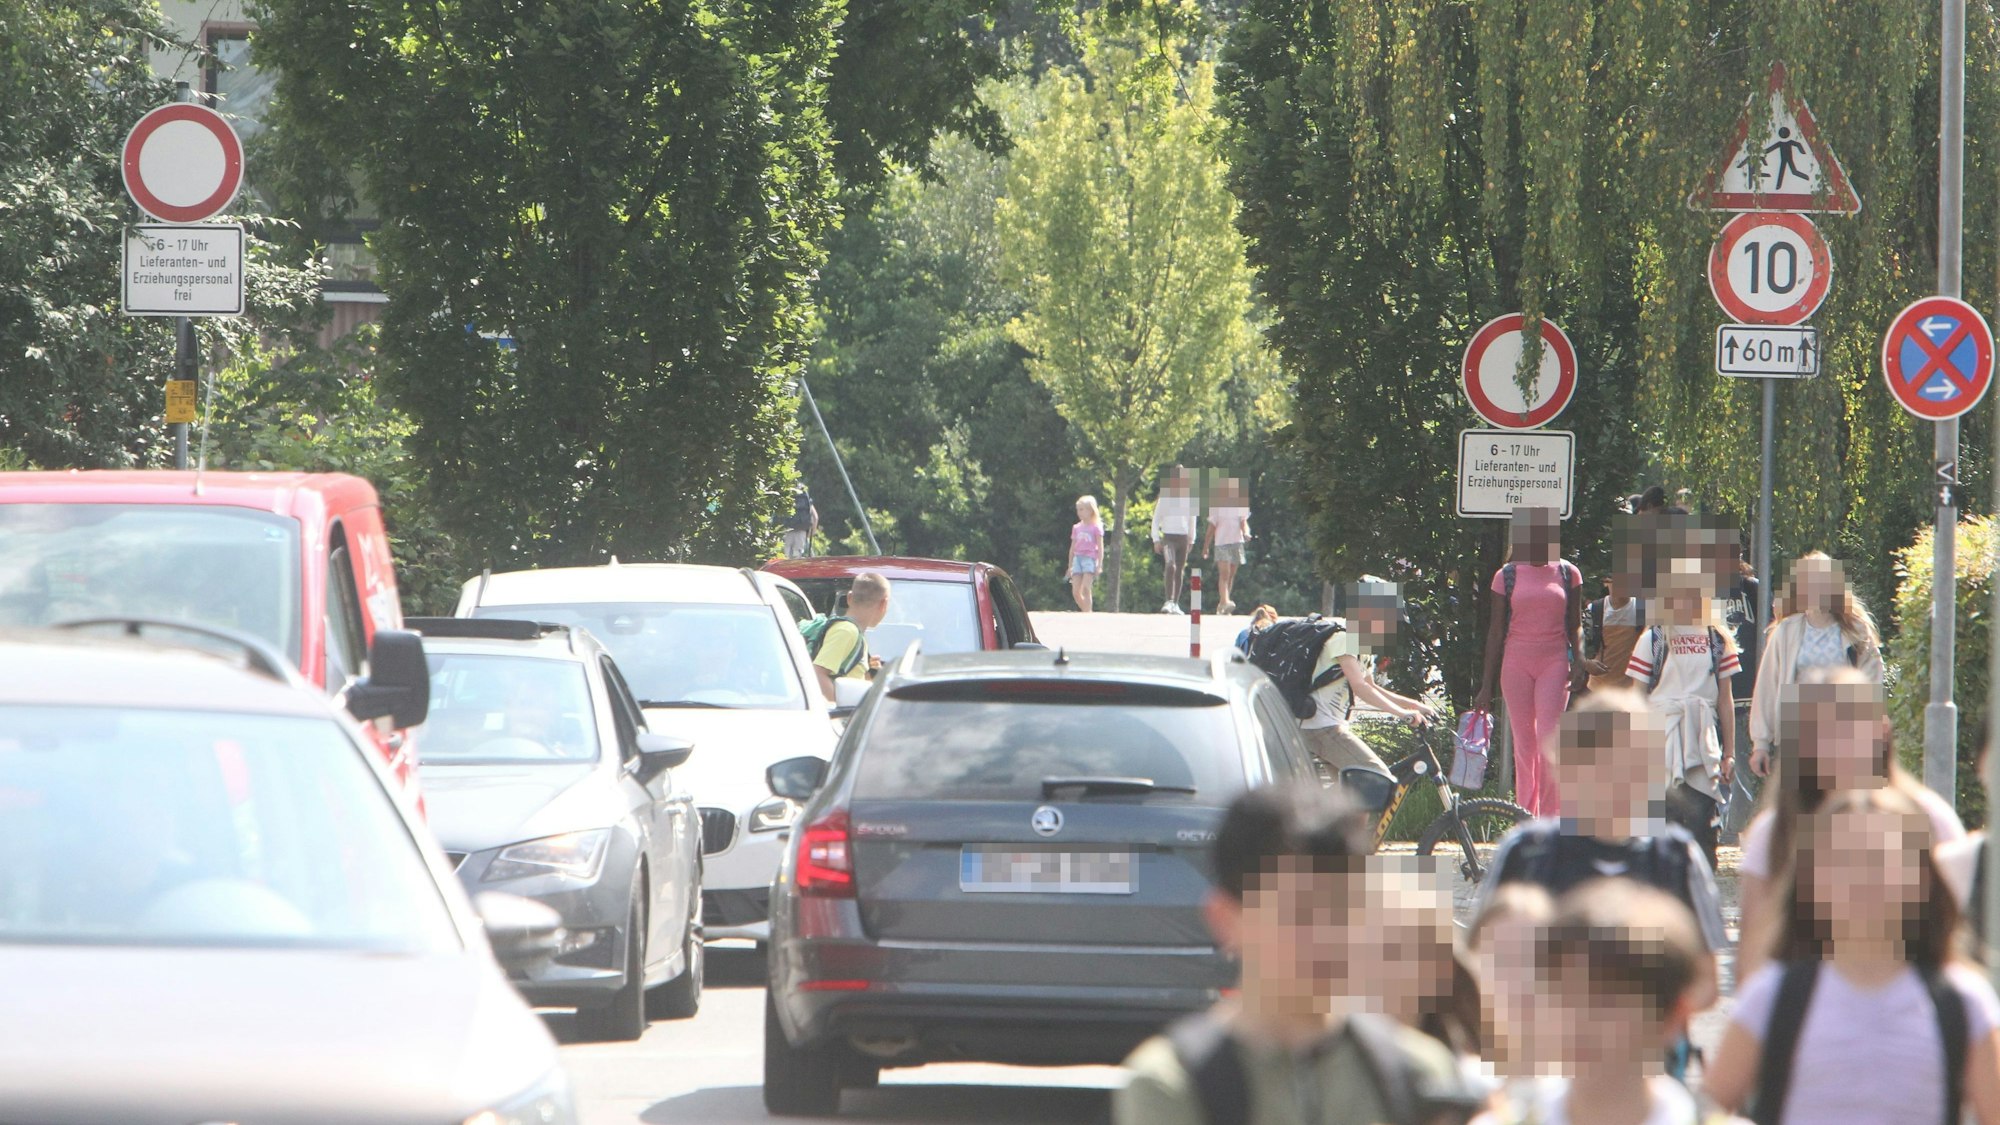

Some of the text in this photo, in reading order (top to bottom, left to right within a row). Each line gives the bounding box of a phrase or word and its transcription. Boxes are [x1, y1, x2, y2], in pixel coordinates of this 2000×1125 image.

[156, 239, 165, 250] 6
[177, 239, 188, 251] 17
[191, 239, 209, 251] Uhr
[140, 256, 226, 267] Lieferanten- und
[1744, 241, 1797, 294] 10
[133, 272, 233, 286] Erziehungspersonal
[174, 289, 192, 301] frei
[1742, 338, 1794, 362] 60 m
[1490, 444, 1498, 456] 6
[1510, 444, 1521, 456] 17
[1524, 445, 1541, 456] Uhr
[1475, 459, 1556, 473] Lieferanten- und
[1468, 475, 1562, 491] Erziehungspersonal
[1506, 492, 1523, 504] frei
[1176, 828, 1218, 841] OCTA
